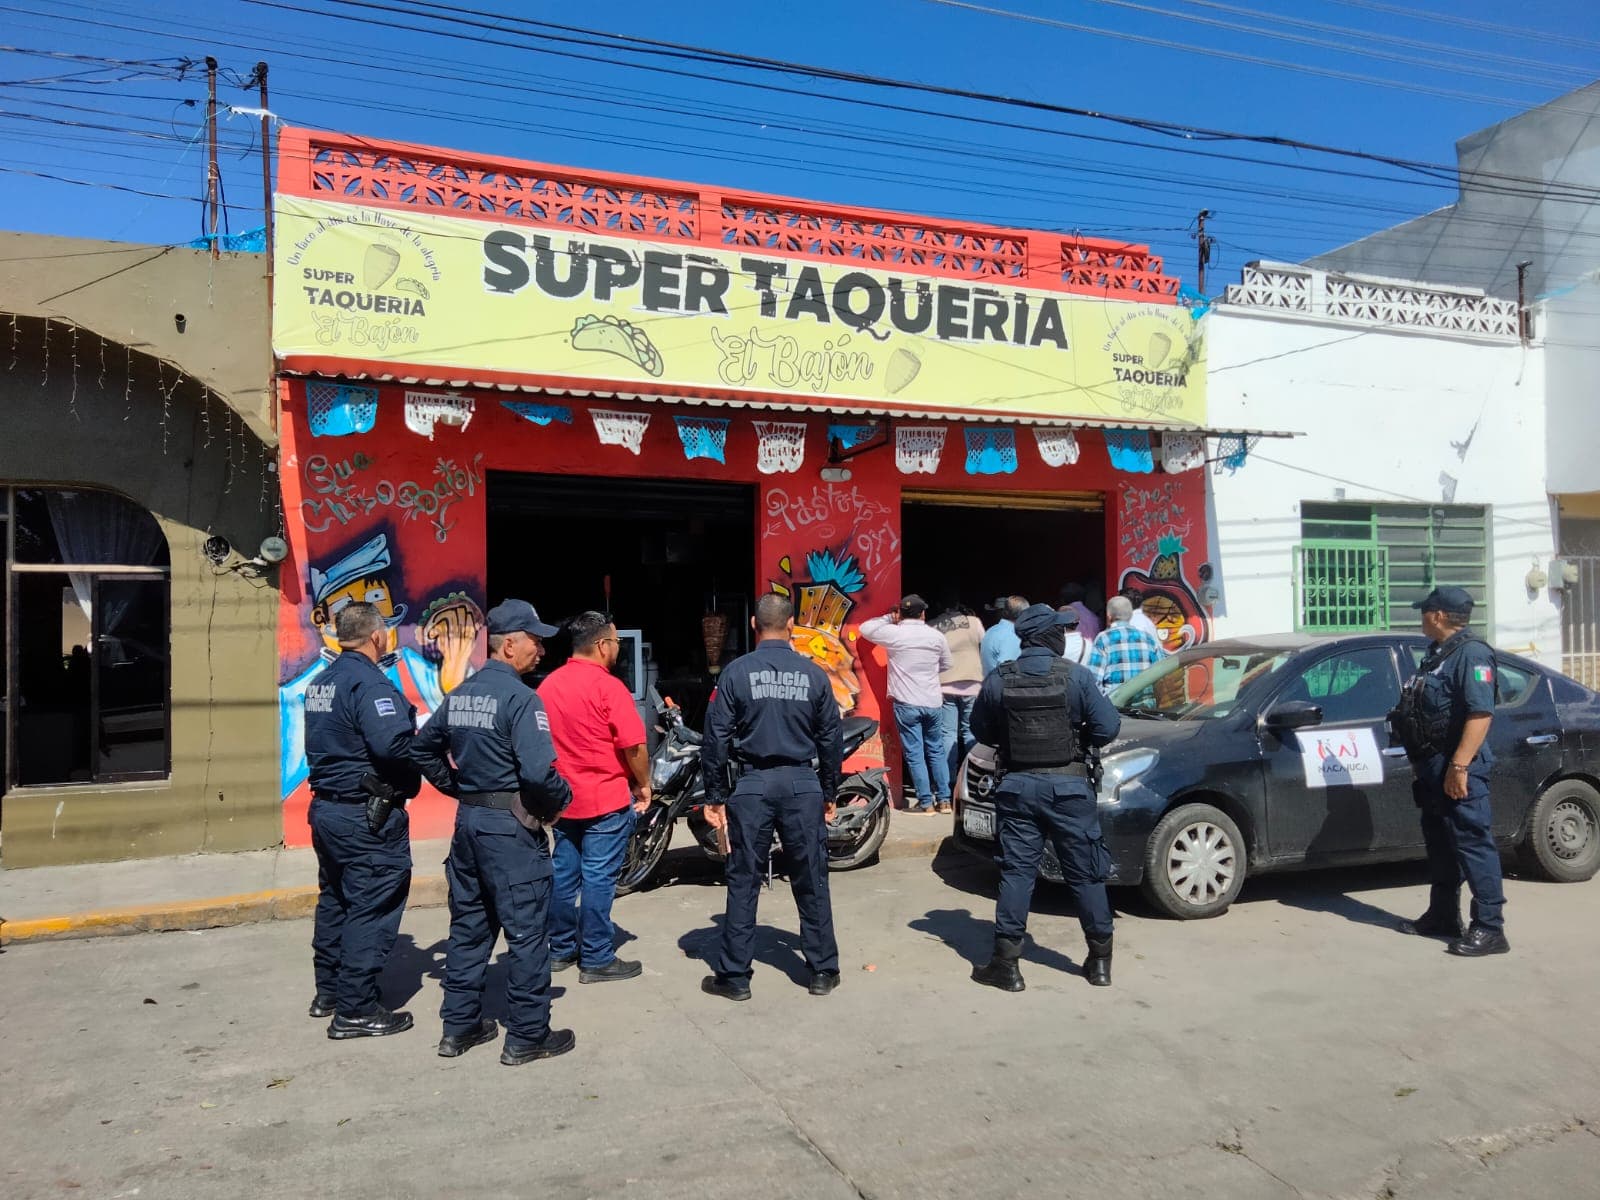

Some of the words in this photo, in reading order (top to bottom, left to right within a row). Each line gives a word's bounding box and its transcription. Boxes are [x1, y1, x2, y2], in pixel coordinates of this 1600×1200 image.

[294, 232, 316, 250] taco
[374, 211, 397, 228] llave
[303, 267, 355, 285] SUPER
[484, 229, 730, 315] SUPER
[311, 310, 342, 346] El
[336, 310, 420, 351] Bajón
[710, 326, 758, 387] El
[750, 326, 874, 393] Bajón
[1112, 352, 1144, 365] SUPER
[749, 670, 811, 688] POLICÍA
